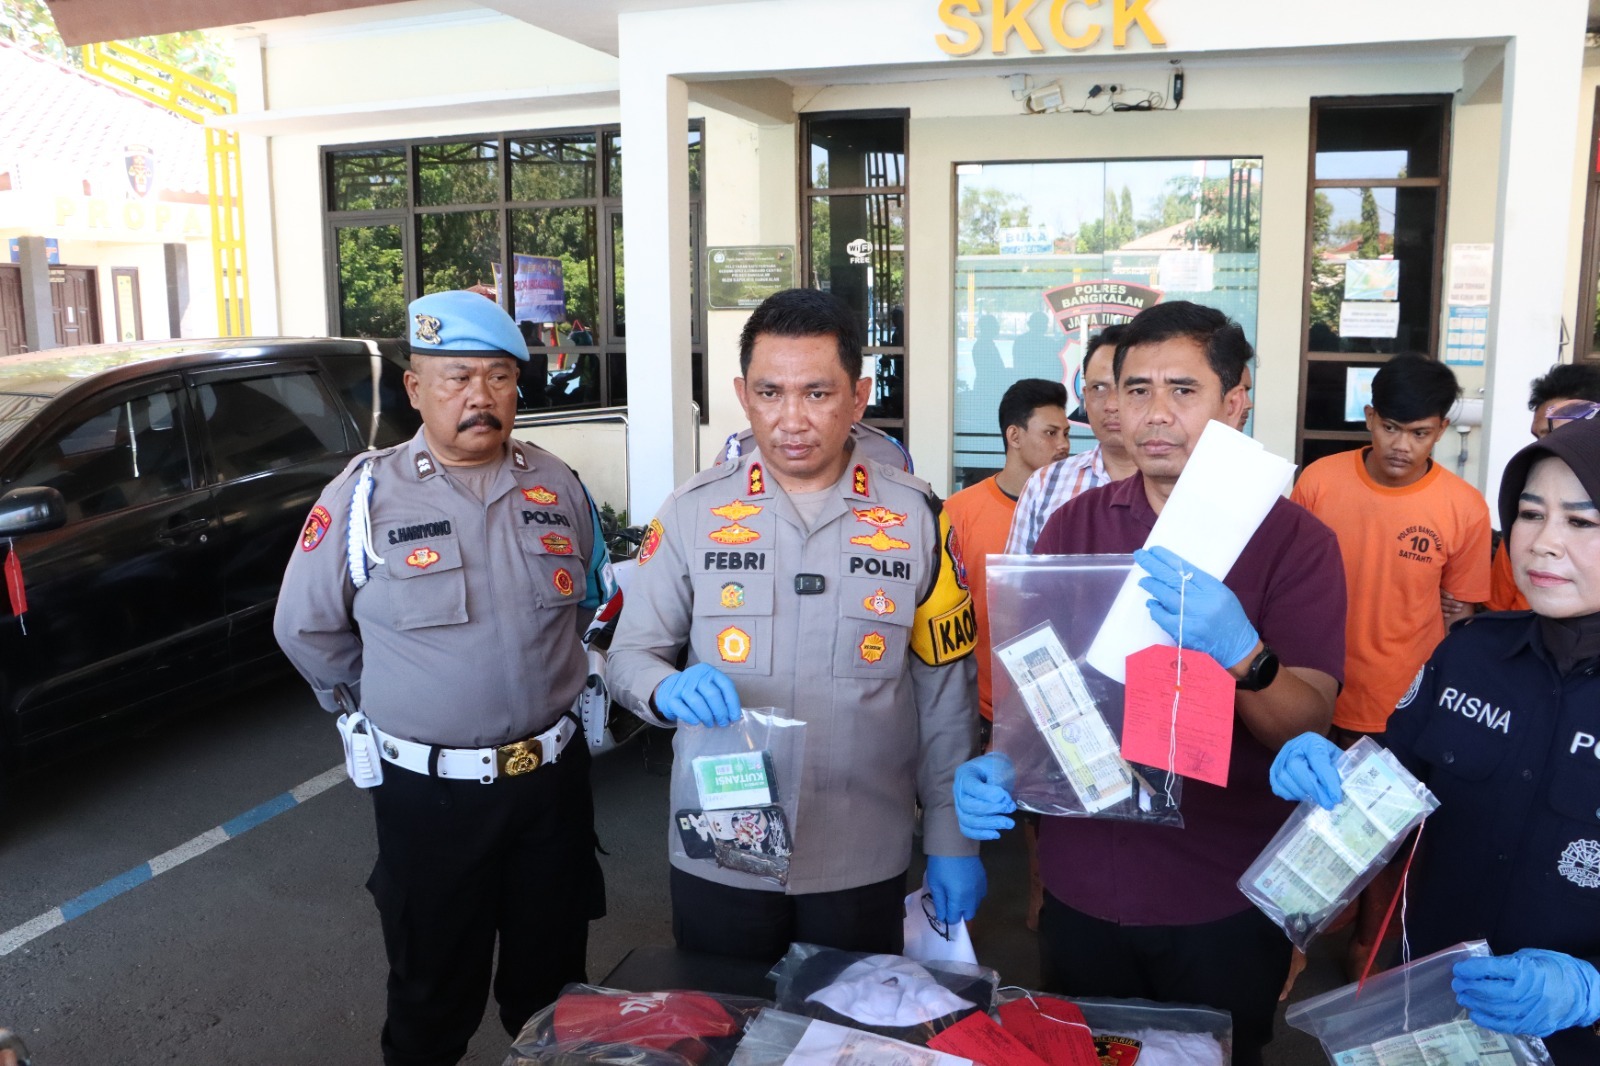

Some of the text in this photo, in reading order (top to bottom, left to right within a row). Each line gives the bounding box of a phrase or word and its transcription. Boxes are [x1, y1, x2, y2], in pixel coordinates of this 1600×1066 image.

[935, 0, 1167, 56] SKCK
[55, 196, 228, 235] PROPA
[1006, 231, 1048, 243] BUKA
[1075, 284, 1127, 295] POLRES
[1061, 293, 1144, 309] BANGKALAN
[1067, 313, 1098, 329] JAA
[522, 510, 571, 528] POLRI
[1397, 525, 1417, 541] POLRES
[1410, 535, 1430, 553] 10
[704, 551, 766, 571] FEBRI
[1398, 549, 1433, 564] SATTAHTI
[849, 556, 911, 580] POLRI
[939, 605, 977, 656] KAO
[1438, 686, 1511, 734] RISNA
[1570, 731, 1600, 760] P
[715, 771, 764, 786] KUITANSI
